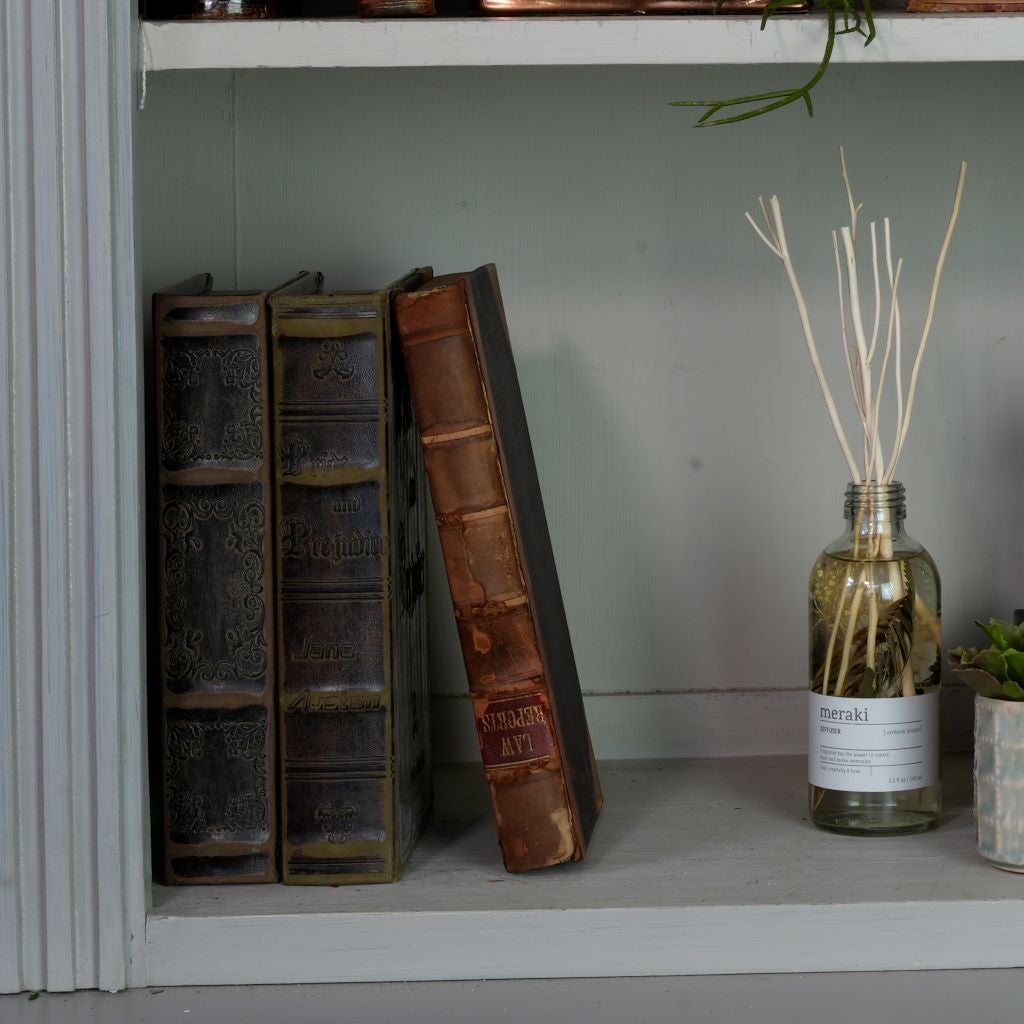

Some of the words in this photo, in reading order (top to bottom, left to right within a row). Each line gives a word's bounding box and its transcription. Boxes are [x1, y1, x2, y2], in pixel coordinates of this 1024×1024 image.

[333, 495, 360, 513] and
[293, 631, 357, 661] Jane
[482, 703, 545, 733] REPORTS
[820, 707, 870, 722] meraki
[501, 733, 533, 756] LAW
